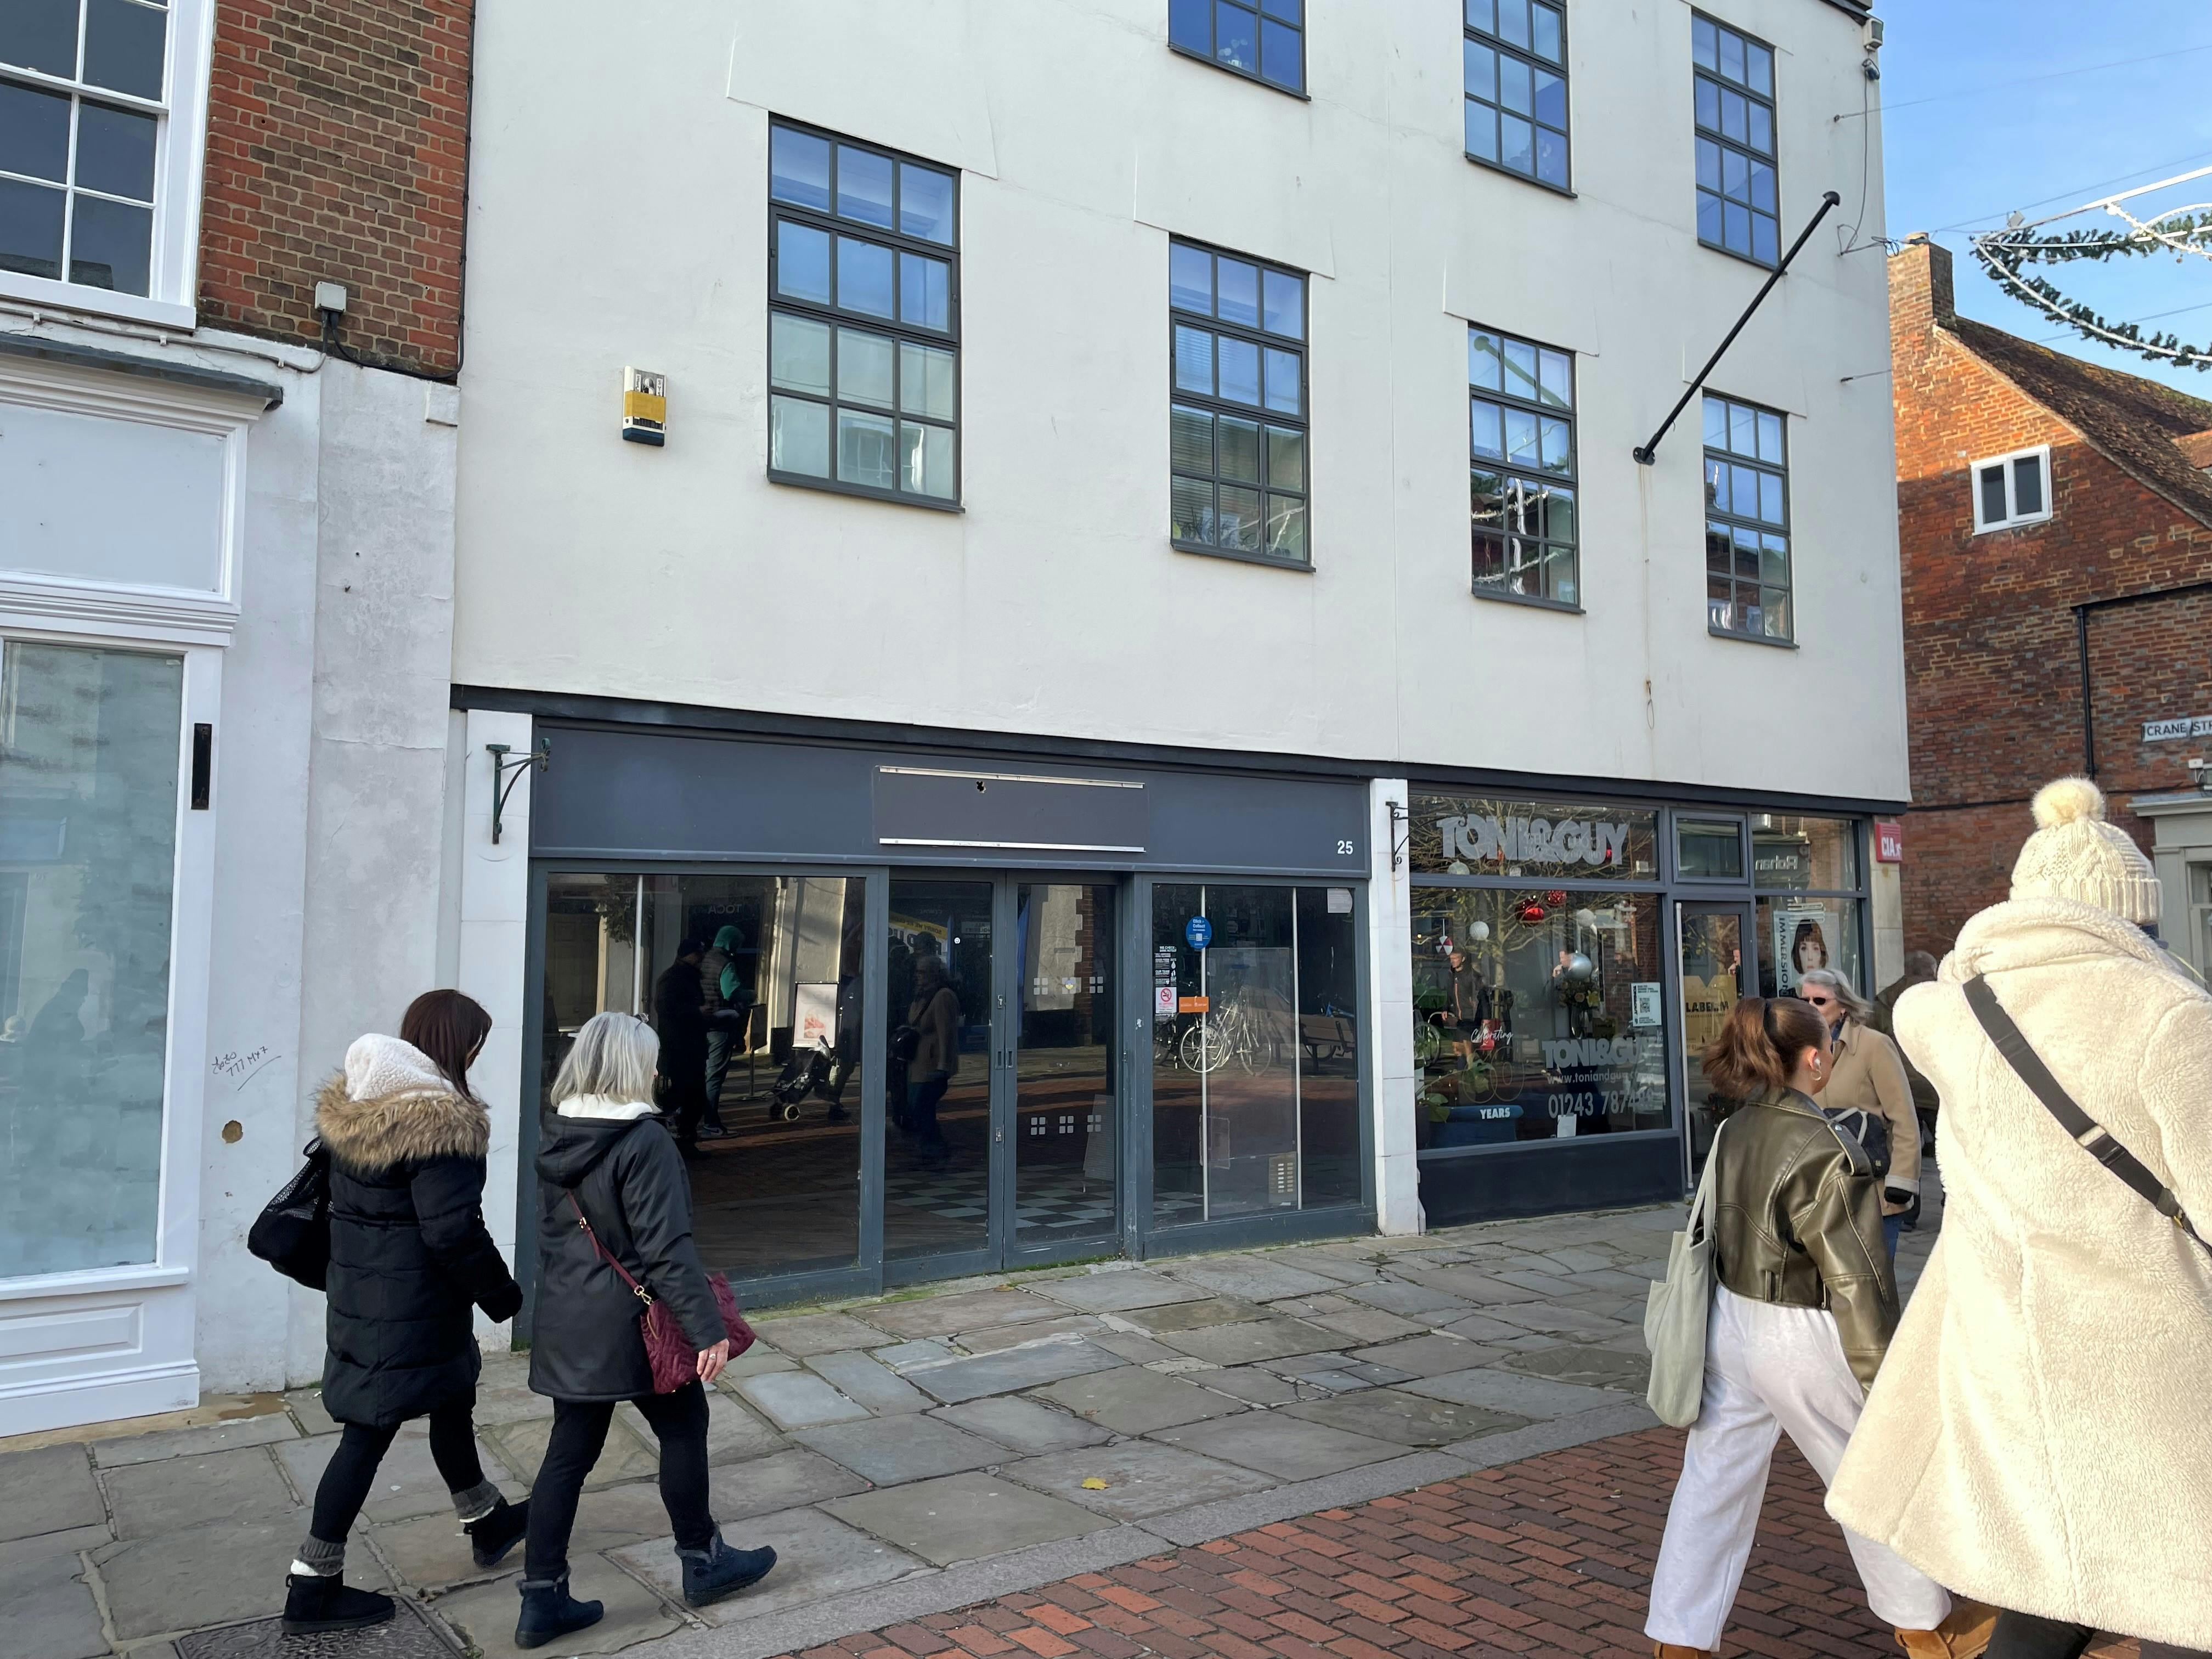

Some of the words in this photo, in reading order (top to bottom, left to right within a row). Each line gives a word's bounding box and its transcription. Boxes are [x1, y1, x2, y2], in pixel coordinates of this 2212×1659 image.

[2146, 723, 2186, 736] CRANE
[1338, 840, 1353, 855] 25
[1436, 812, 1630, 865] TONI&GUY
[1881, 837, 1895, 857] CIA
[1779, 917, 1789, 992] IMMERSION
[1480, 1108, 1510, 1120] YEARS
[1548, 1092, 1594, 1119] 01243
